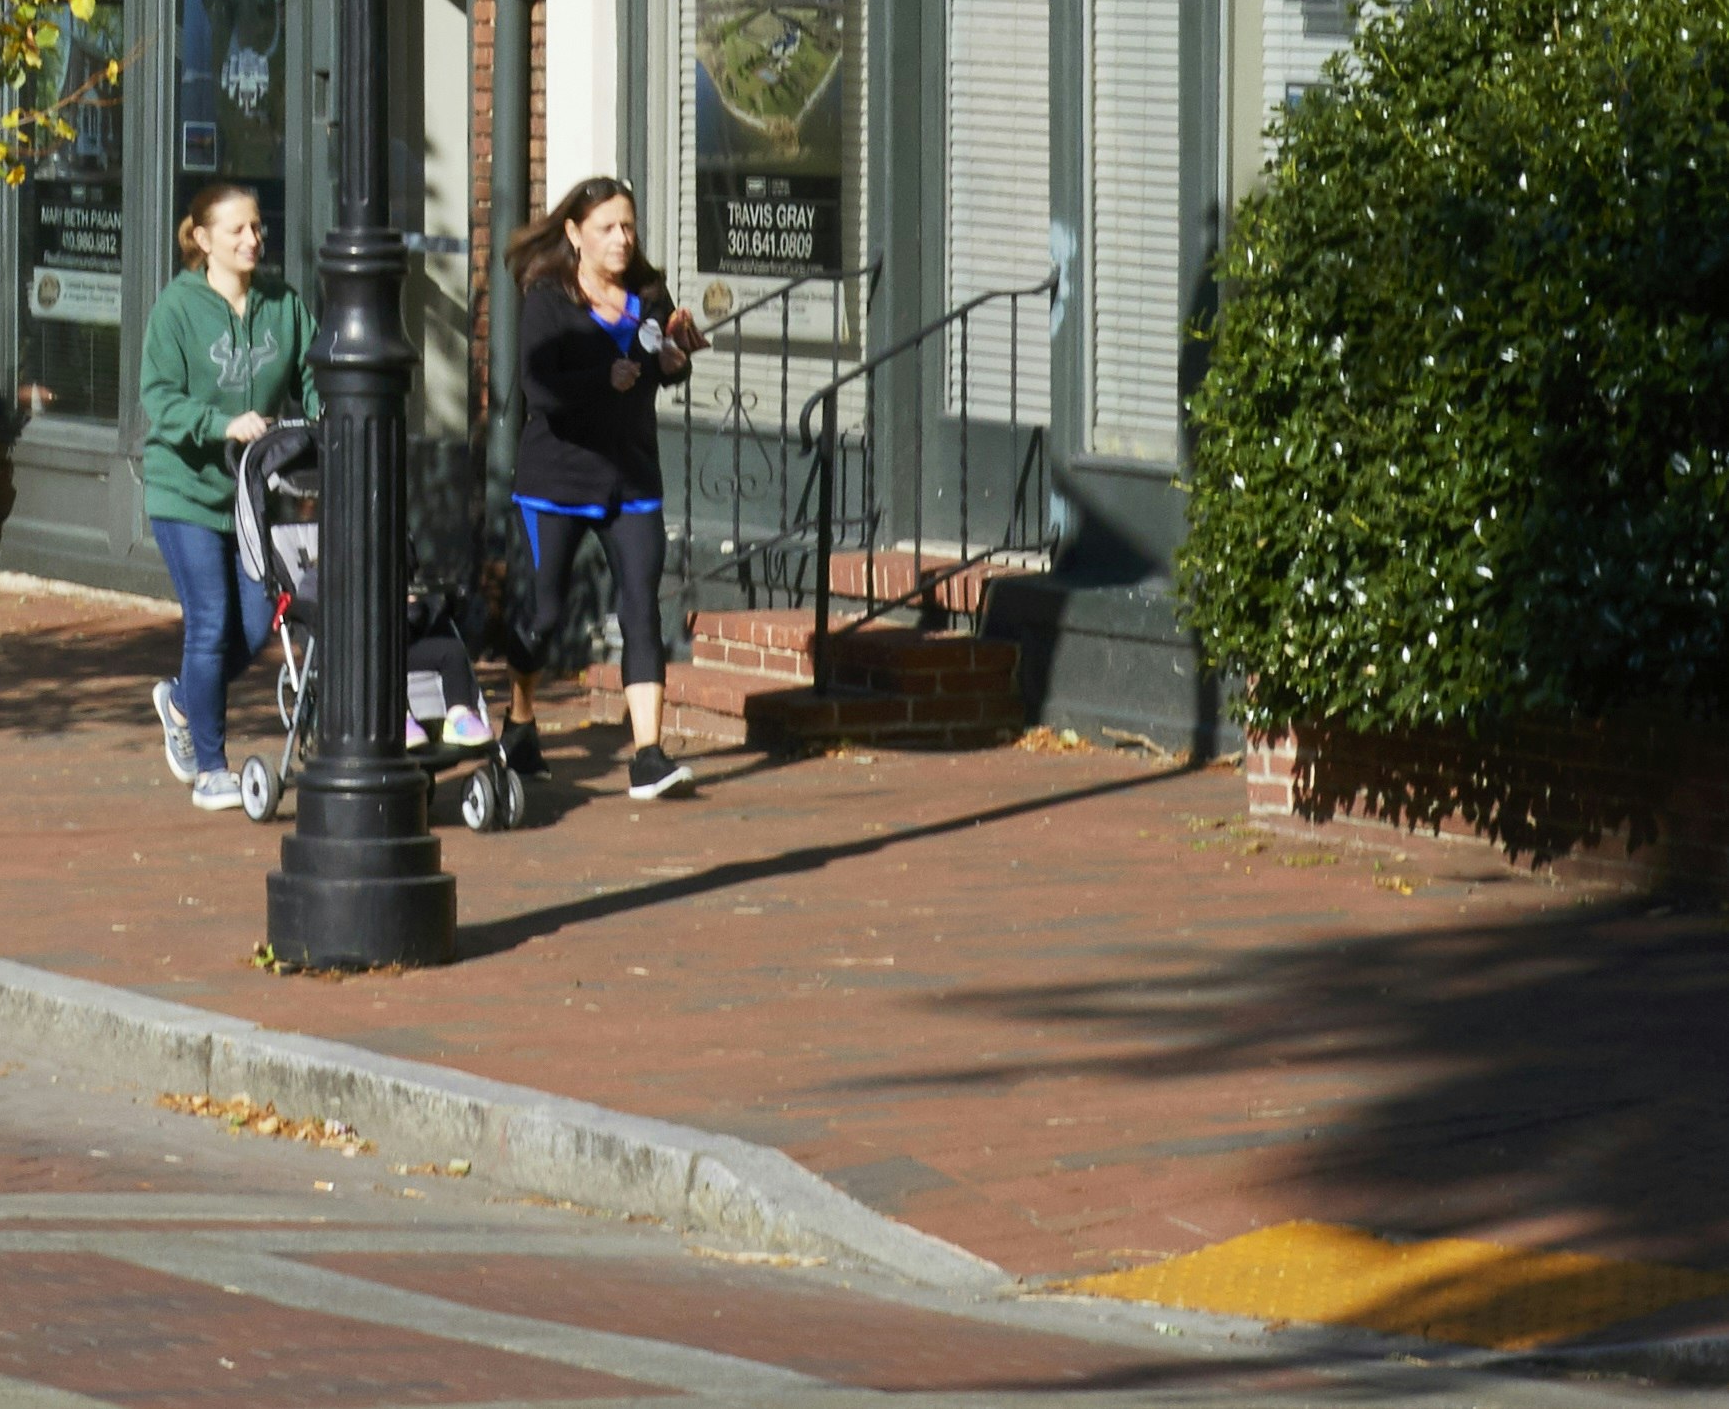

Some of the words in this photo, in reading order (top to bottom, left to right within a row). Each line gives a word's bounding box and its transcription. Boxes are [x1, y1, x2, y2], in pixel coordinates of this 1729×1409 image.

[727, 201, 773, 228] TRAVIS
[776, 203, 815, 229] GRAY
[727, 229, 813, 259] 301.641.0809
